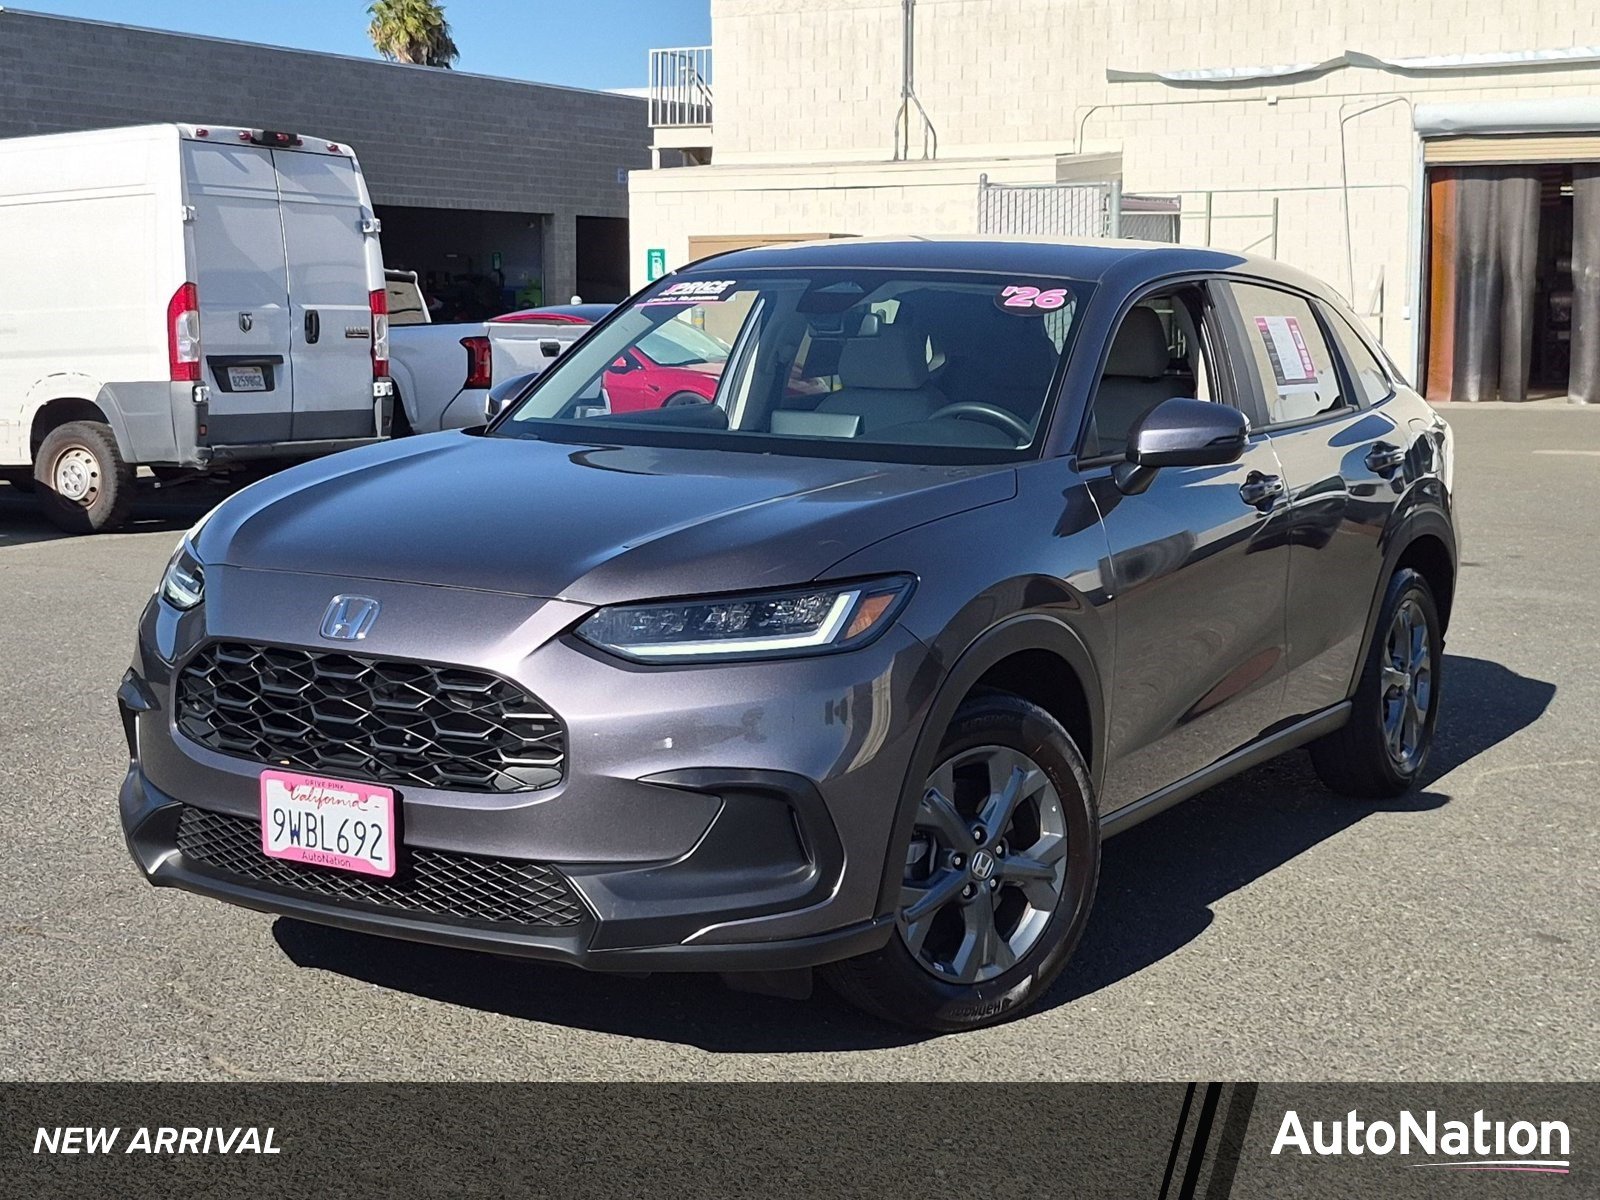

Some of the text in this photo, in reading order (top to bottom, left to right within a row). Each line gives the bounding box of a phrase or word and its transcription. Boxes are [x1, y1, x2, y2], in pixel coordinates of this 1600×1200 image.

[290, 786, 368, 811] California
[273, 808, 383, 861] 9WBL692
[301, 851, 351, 867] AutoNation
